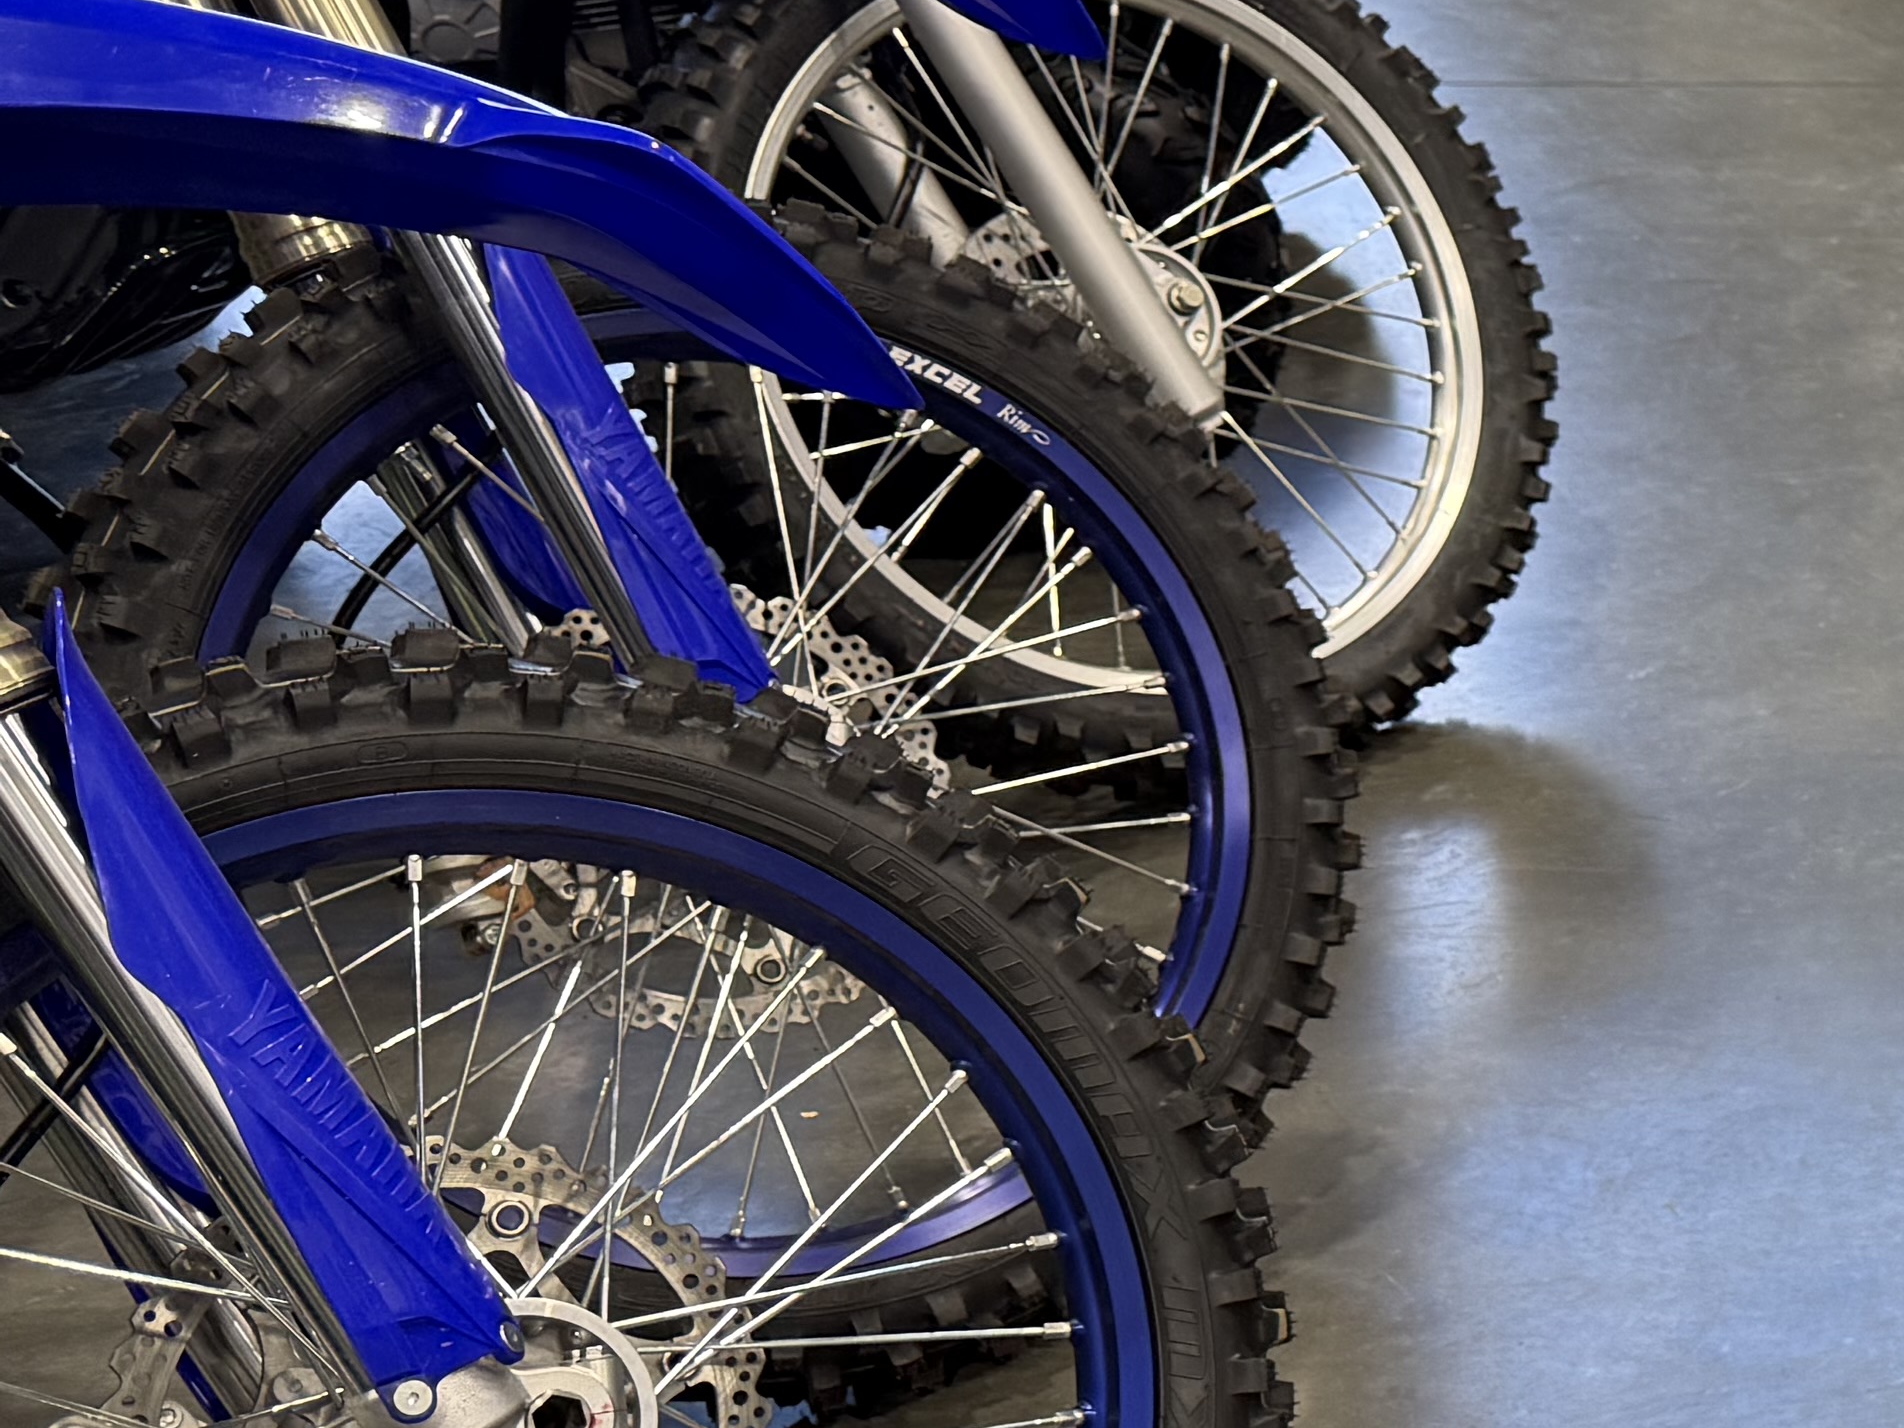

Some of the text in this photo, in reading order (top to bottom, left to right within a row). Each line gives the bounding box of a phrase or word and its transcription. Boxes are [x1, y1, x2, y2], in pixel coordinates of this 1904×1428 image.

[889, 345, 985, 404] EXCEL
[229, 979, 452, 1248] YAMAHA
[848, 844, 1188, 1241] GEOMAX
